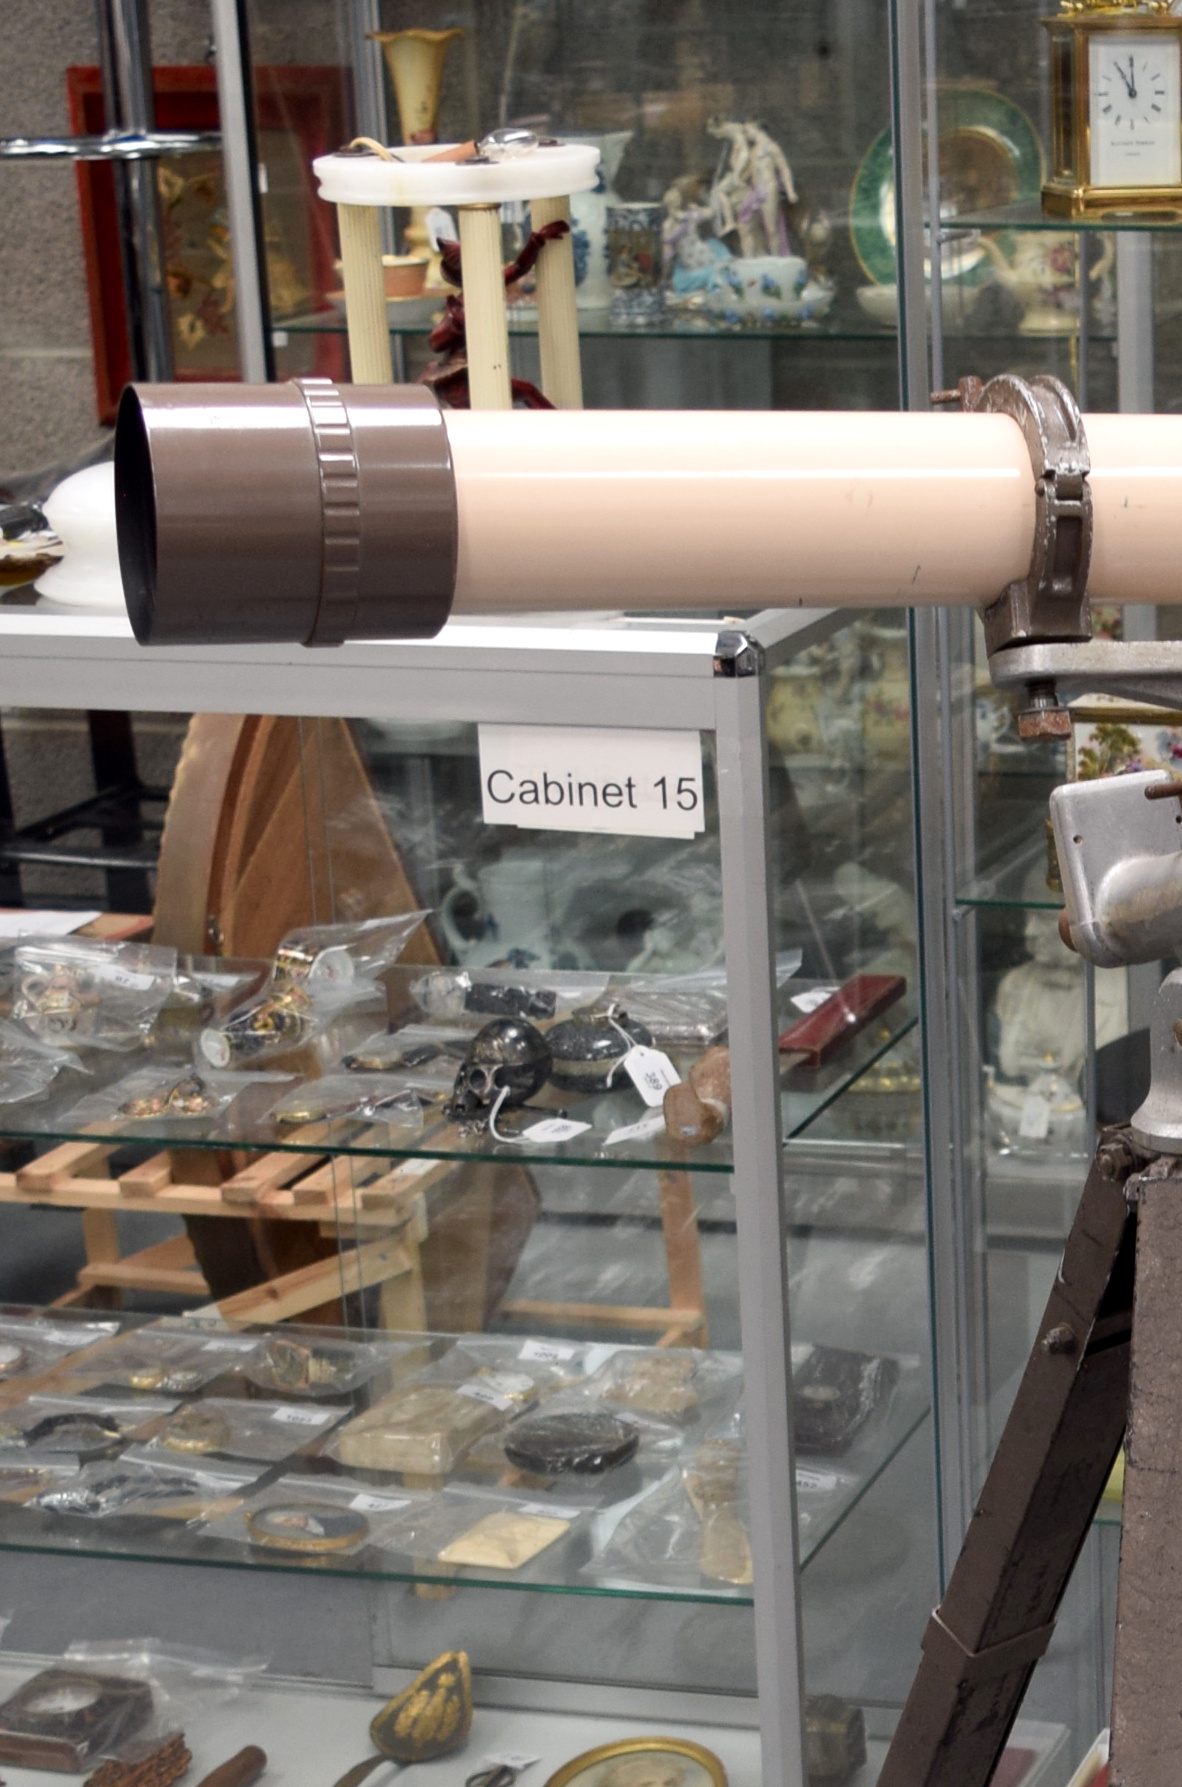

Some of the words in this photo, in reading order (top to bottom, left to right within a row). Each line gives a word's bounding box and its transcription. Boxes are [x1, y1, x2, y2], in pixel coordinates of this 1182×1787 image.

[487, 769, 638, 809] Cabinet
[653, 776, 698, 811] 15
[645, 1071, 663, 1091] 389
